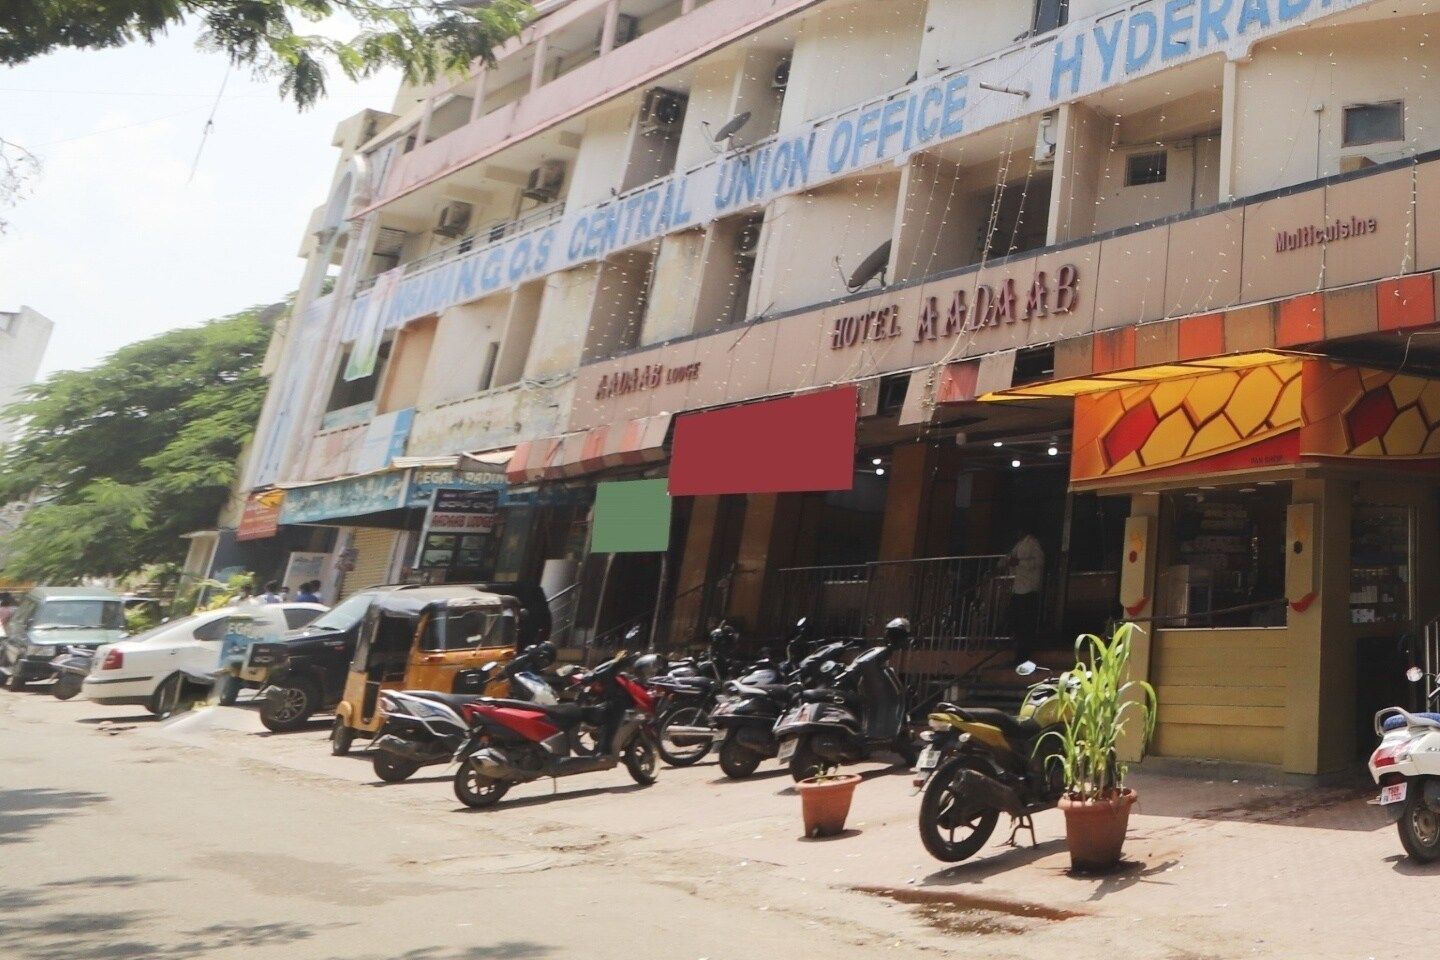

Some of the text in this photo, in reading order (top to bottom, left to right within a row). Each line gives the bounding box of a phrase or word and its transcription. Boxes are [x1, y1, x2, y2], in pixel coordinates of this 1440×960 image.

[568, 179, 692, 262] CENTRAL
[714, 133, 816, 210] UNION
[826, 75, 969, 173] OFFICE
[1275, 215, 1378, 253] Multicuisine
[831, 263, 1079, 350] HOTEL AADAAB
